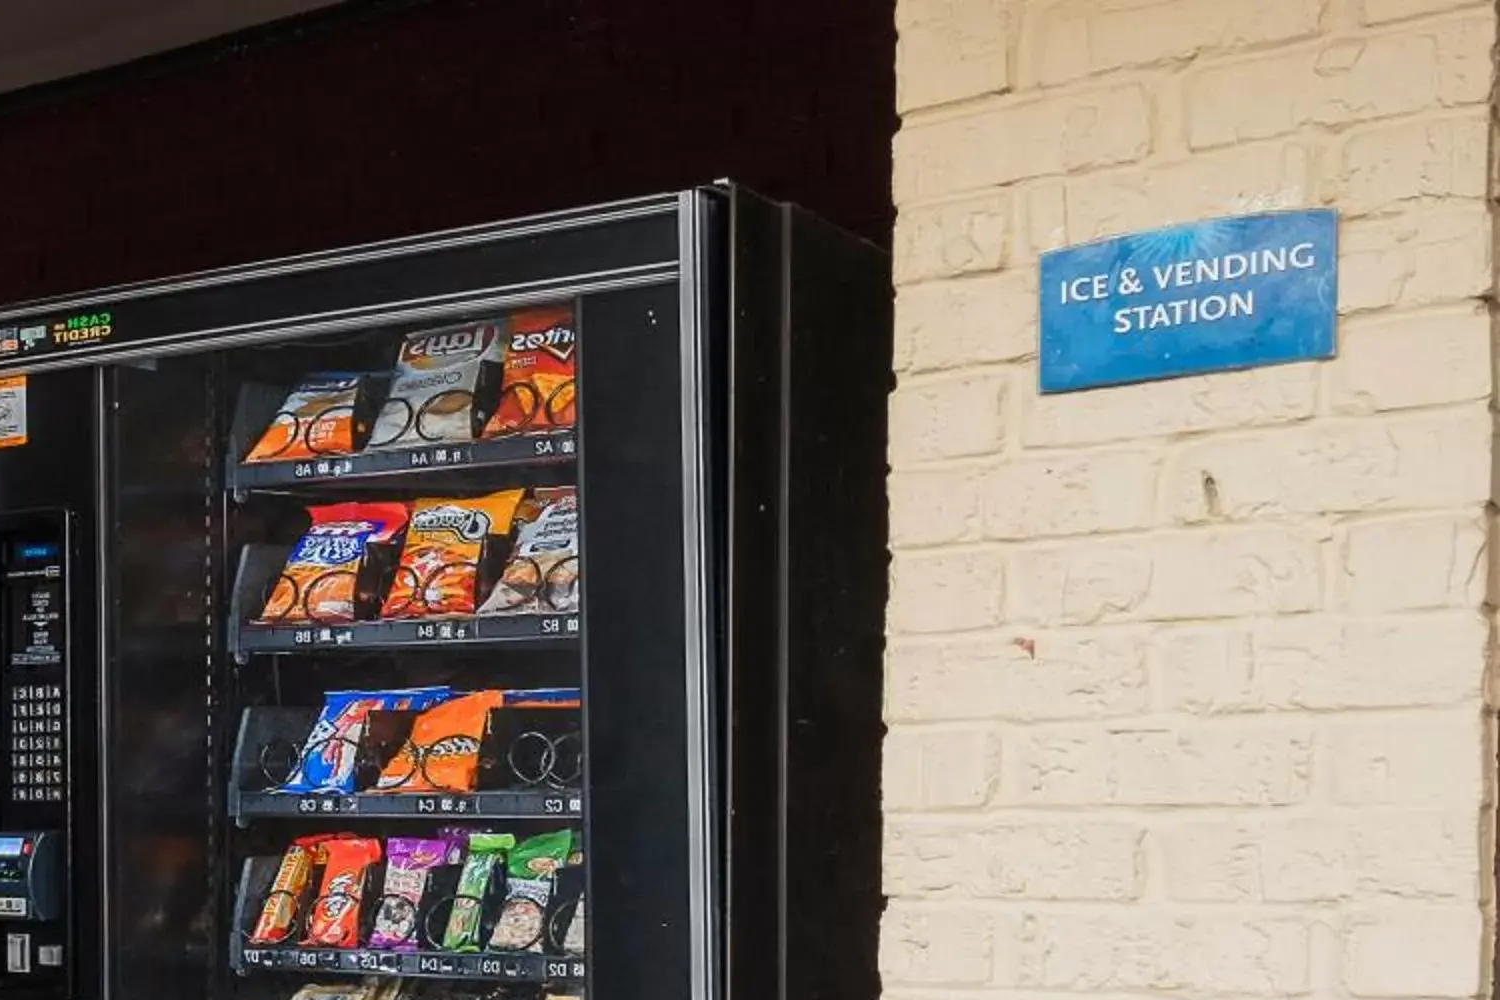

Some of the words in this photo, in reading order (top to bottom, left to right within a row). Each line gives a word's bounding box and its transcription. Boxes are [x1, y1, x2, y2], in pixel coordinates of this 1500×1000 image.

[1061, 272, 1109, 304] ICE
[1118, 266, 1144, 296] &
[1153, 241, 1316, 289] VENDING
[1114, 289, 1254, 334] STATION
